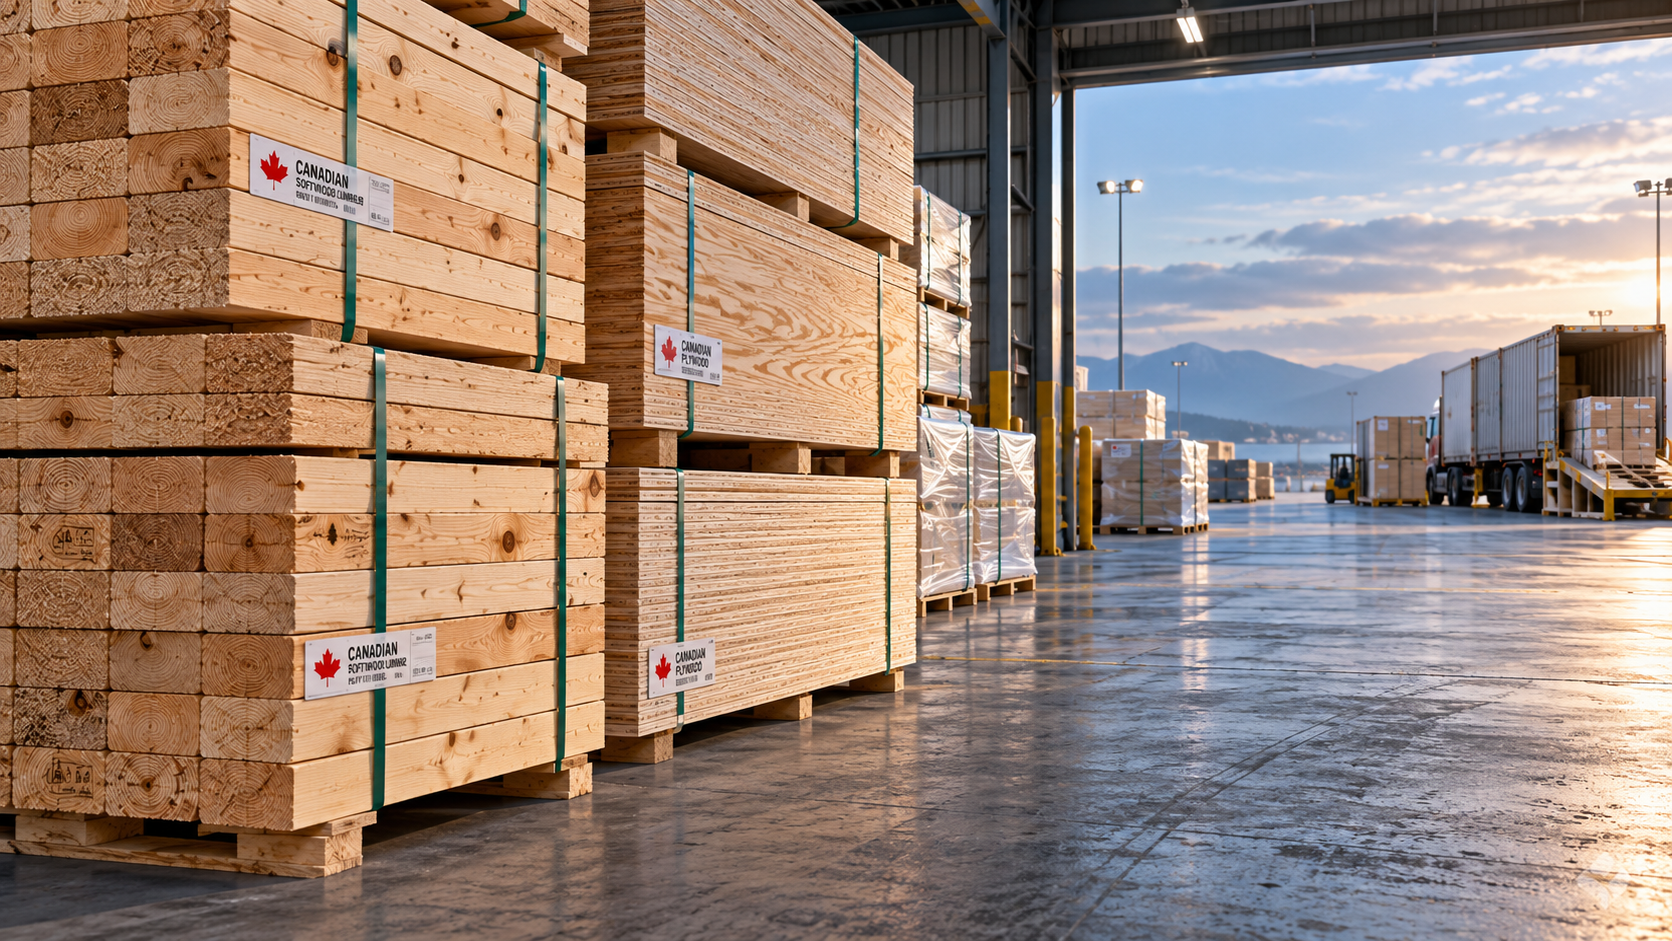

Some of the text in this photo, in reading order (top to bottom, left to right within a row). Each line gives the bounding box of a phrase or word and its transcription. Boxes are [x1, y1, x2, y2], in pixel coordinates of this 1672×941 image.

[296, 160, 349, 189] CANADIAN
[681, 340, 712, 357] CANADIAN
[348, 641, 398, 661] CANADIAN
[675, 647, 706, 664] CANADIAN
